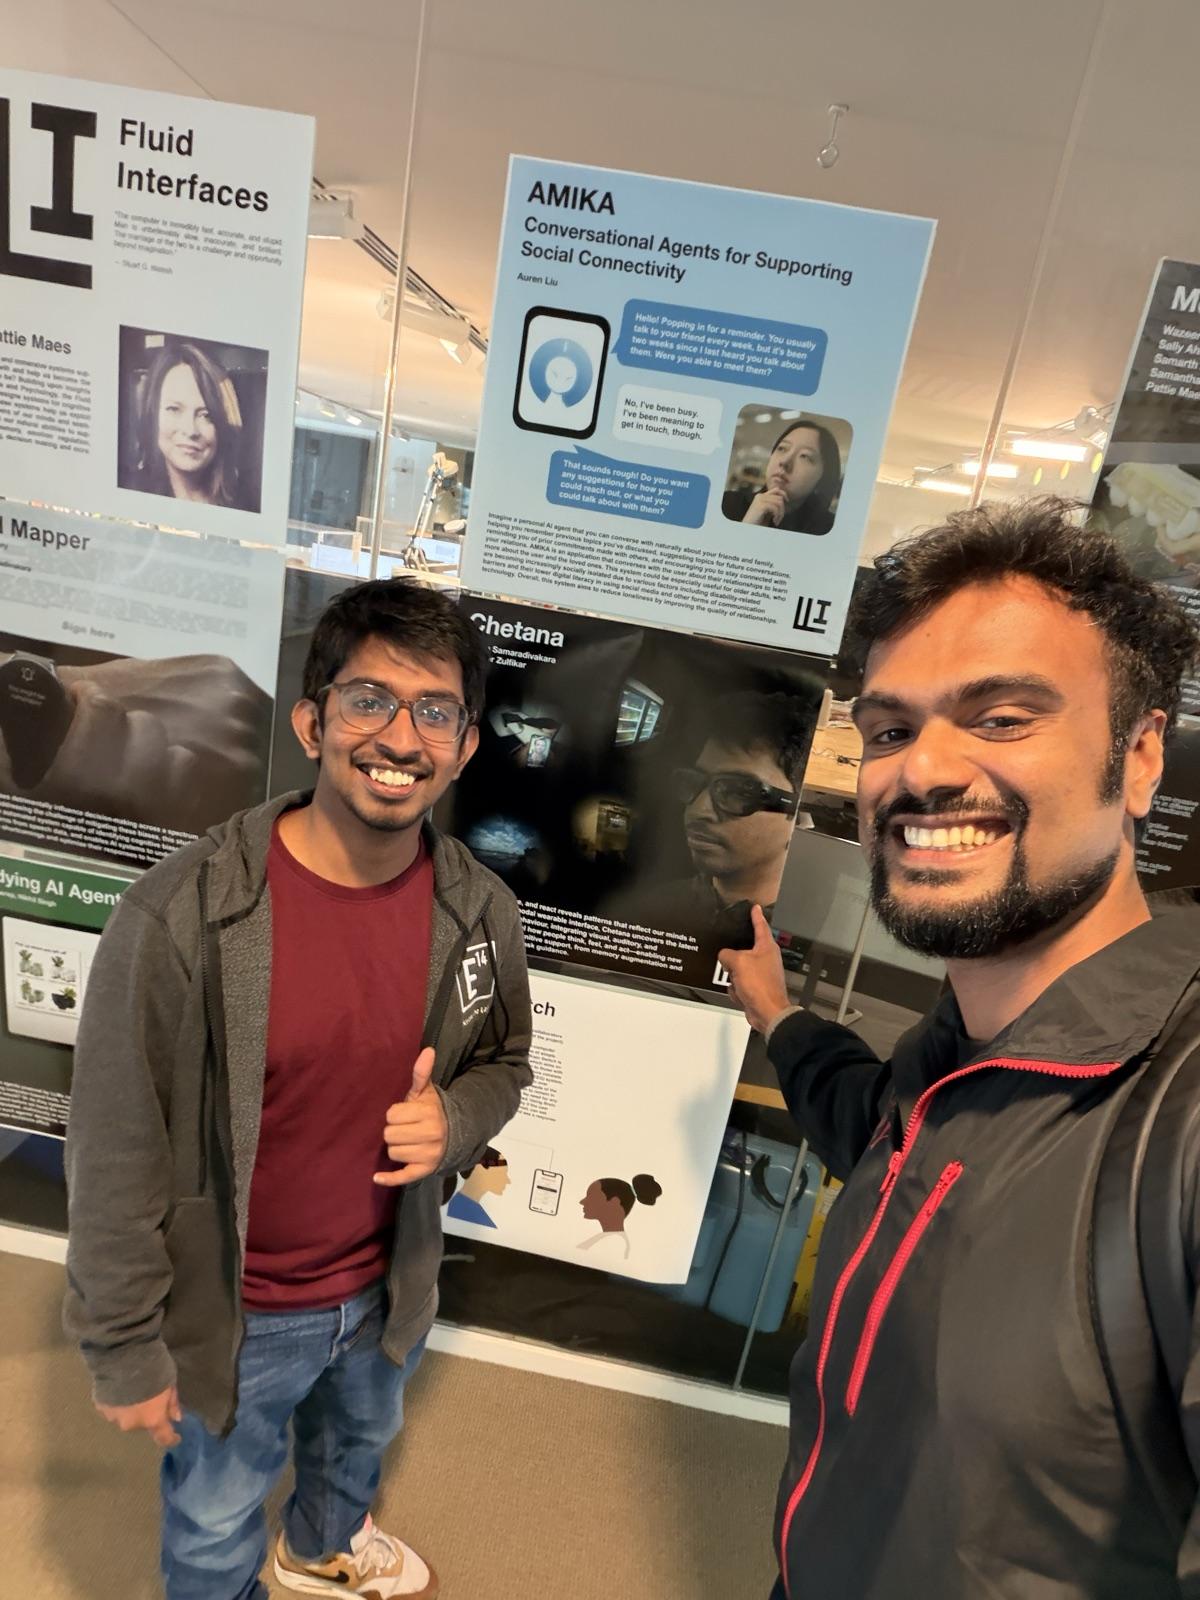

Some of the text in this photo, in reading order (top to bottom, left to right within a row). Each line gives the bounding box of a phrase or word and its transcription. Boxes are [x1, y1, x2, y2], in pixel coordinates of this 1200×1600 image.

[120, 118, 194, 157] Fluid
[117, 161, 270, 212] Interfaces
[527, 180, 615, 216] AMIKA
[520, 240, 686, 284] Social Connectivity
[524, 215, 853, 287] Conversational Agents for Supporting
[516, 272, 558, 287] Auren Liu
[32, 334, 72, 355] Maes
[633, 324, 649, 334] talk
[649, 326, 660, 336] to
[659, 329, 680, 338] your
[680, 330, 706, 343] friend
[706, 336, 730, 348] every
[755, 343, 771, 354] but
[771, 346, 785, 356] it's
[785, 348, 808, 360] been
[634, 312, 660, 324] Hello!
[660, 316, 696, 332] Popping
[696, 322, 705, 331] in
[706, 323, 720, 334] for
[719, 327, 726, 335] a
[768, 333, 785, 344] You
[785, 338, 817, 352] usually
[1158, 338, 1184, 354] Sally
[631, 335, 805, 371] two weeks since I last heard you talk about
[654, 349, 676, 361] Were
[676, 354, 693, 364] you
[693, 356, 712, 367] able
[713, 359, 722, 368] to
[723, 362, 745, 372] meet
[745, 364, 773, 376] them?
[1153, 353, 1198, 370] Samarth
[1144, 381, 1176, 396] Pattie
[622, 408, 705, 430] I've been meaning to
[639, 400, 654, 410] I've
[655, 403, 676, 414] been
[620, 420, 634, 429] get
[635, 422, 644, 430] in
[561, 471, 673, 496] any suggestions for how you
[563, 458, 690, 489] That sounds rough! Do you want
[558, 491, 665, 515] could talk about with them?
[559, 481, 583, 491] could
[582, 485, 606, 495] reach
[623, 492, 633, 500] or
[633, 493, 654, 503] what
[653, 497, 670, 506] you
[10, 517, 91, 551] Mapper
[488, 512, 513, 522] Imagine
[518, 518, 546, 527] personal
[553, 524, 571, 532] agent
[610, 534, 640, 544] converse
[654, 542, 682, 553] naturally
[682, 546, 702, 555] about
[701, 550, 717, 558] your
[717, 551, 740, 562] friends
[61, 620, 116, 640] Sign here
[469, 611, 565, 648] Chetana
[491, 645, 557, 664] Samaradivakara
[495, 656, 527, 669] Zulfikar
[45, 879, 64, 896] AI
[524, 900, 539, 909] and
[538, 904, 557, 914] react
[557, 908, 583, 919] reveals
[582, 914, 613, 926] patterns
[612, 920, 628, 929] that
[627, 924, 652, 934] reflect
[664, 932, 688, 942] minds
[688, 935, 696, 943] in
[536, 912, 568, 924] wearable
[601, 925, 631, 938] Chetana
[631, 933, 665, 945] uncovers
[665, 939, 678, 948] the
[677, 941, 699, 952] latent
[526, 925, 542, 935] how
[542, 930, 567, 940] people
[603, 943, 618, 951] and
[666, 956, 682, 964] new
[549, 922, 588, 938] integrating
[643, 943, 658, 951] and
[573, 943, 591, 953] from
[590, 948, 620, 960] memory
[620, 954, 668, 969] augmentation
[668, 964, 683, 972] and
